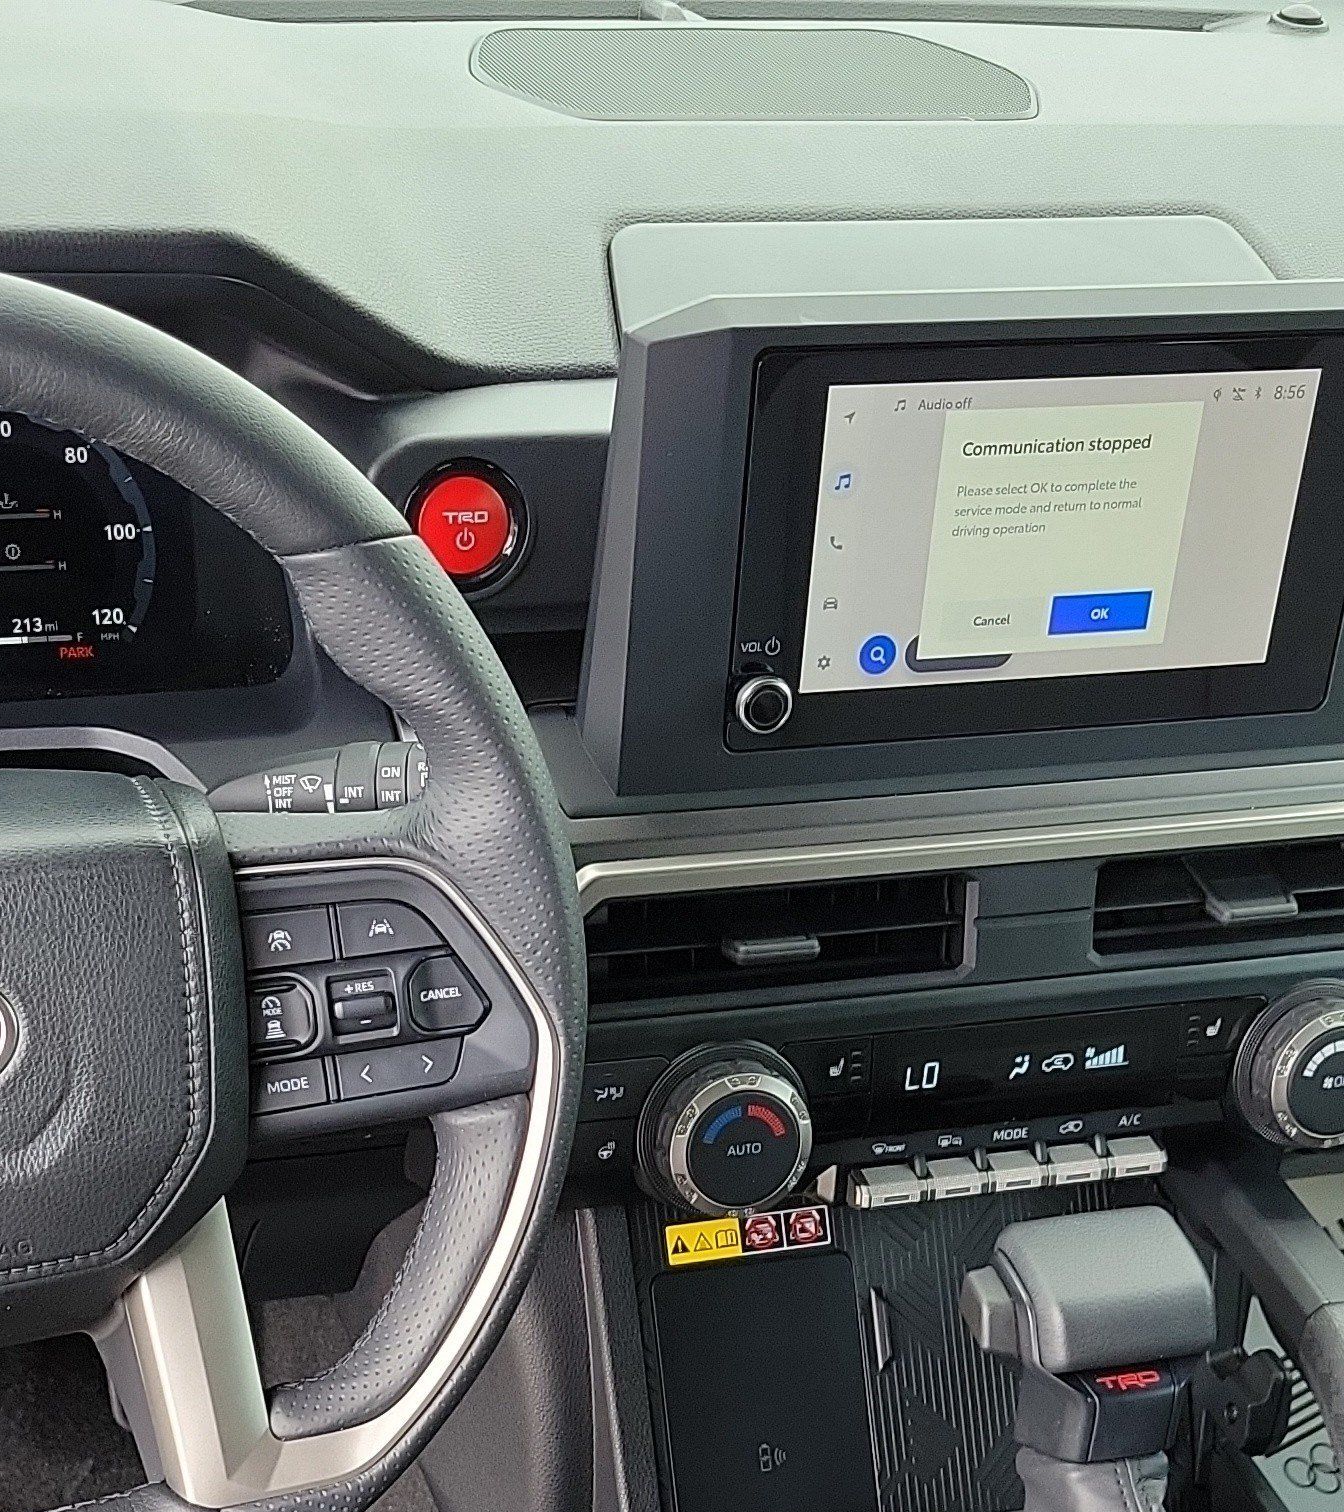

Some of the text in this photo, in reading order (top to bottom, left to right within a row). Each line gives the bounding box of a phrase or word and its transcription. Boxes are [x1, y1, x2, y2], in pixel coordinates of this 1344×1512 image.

[1272, 383, 1307, 402] 8:56
[917, 397, 973, 412] Audio off
[962, 434, 1153, 457] Communication stopped
[64, 446, 89, 465] 80
[956, 478, 1138, 498] Please select OK to complete the
[53, 510, 62, 520] H
[954, 498, 1143, 517] service mode and return to normal
[442, 511, 489, 525] TRD
[103, 523, 136, 541] 100
[952, 523, 1046, 538] driving operation
[58, 561, 67, 571] H
[91, 607, 124, 626] 120
[972, 612, 1011, 628] Cancel
[1089, 606, 1111, 622] OK
[11, 617, 58, 634] 213 mi
[77, 632, 84, 642] F
[100, 632, 120, 641] MPH
[59, 645, 95, 659] PARK
[740, 640, 763, 654] VOL
[381, 766, 401, 778] ON
[272, 774, 298, 786] MIST
[273, 786, 294, 797] OFF
[344, 786, 365, 799] INT
[381, 790, 402, 803] INT
[274, 798, 293, 809] INT
[420, 986, 462, 1002] CANCEL
[262, 1006, 284, 1016] MODE
[904, 1061, 941, 1092] LO
[267, 1077, 310, 1095] MODE
[1118, 1112, 1142, 1128] A/C
[992, 1126, 1029, 1142] MODE
[726, 1141, 762, 1158] AUTO
[884, 1143, 906, 1153] FRONT
[1096, 1369, 1160, 1392] TRD
